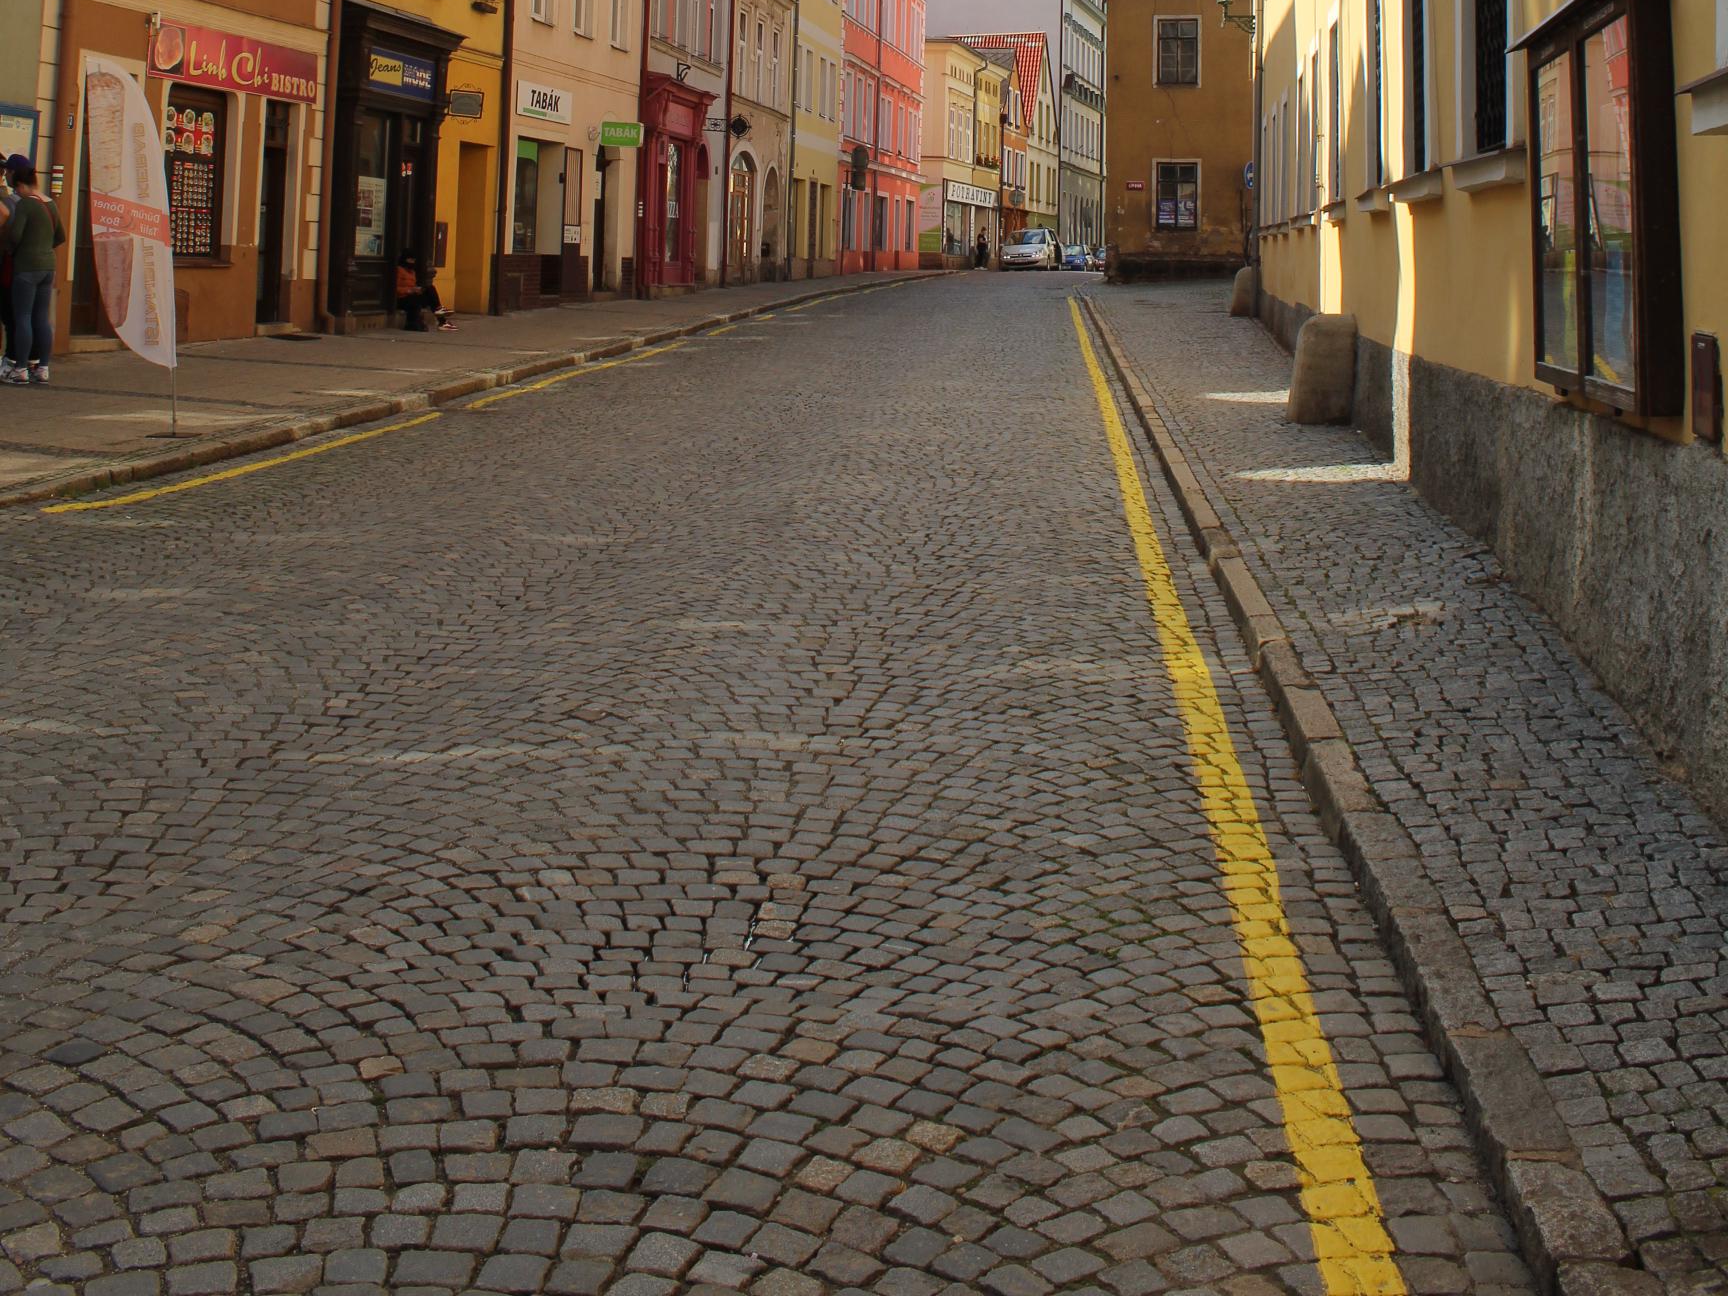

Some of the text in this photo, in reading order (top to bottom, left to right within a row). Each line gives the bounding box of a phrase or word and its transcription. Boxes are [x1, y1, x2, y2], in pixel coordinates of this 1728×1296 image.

[189, 39, 315, 98] Linh Chi BISTRO
[370, 57, 402, 77] Jeans
[530, 89, 560, 113] TABÁK
[951, 184, 993, 204] POTRAVINY
